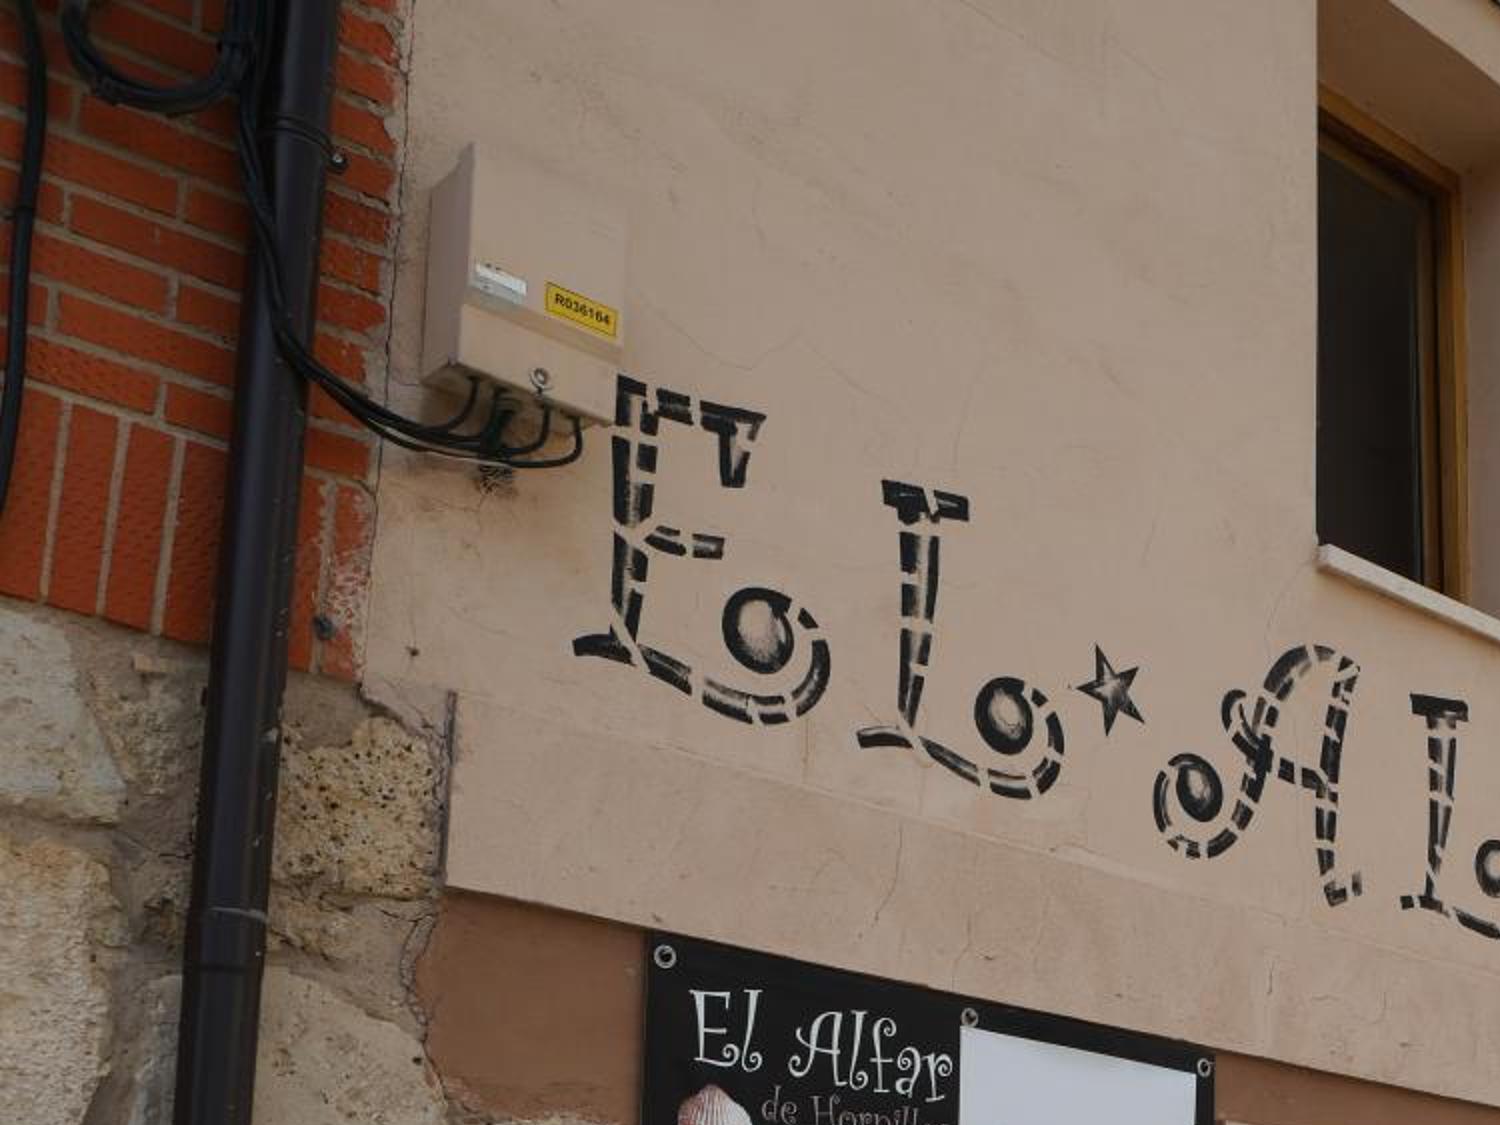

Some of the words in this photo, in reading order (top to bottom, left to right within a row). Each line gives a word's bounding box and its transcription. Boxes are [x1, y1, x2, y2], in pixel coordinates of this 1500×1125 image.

[571, 374, 1067, 800] EL
[689, 988, 764, 1073] El
[787, 1010, 954, 1103] Alfar
